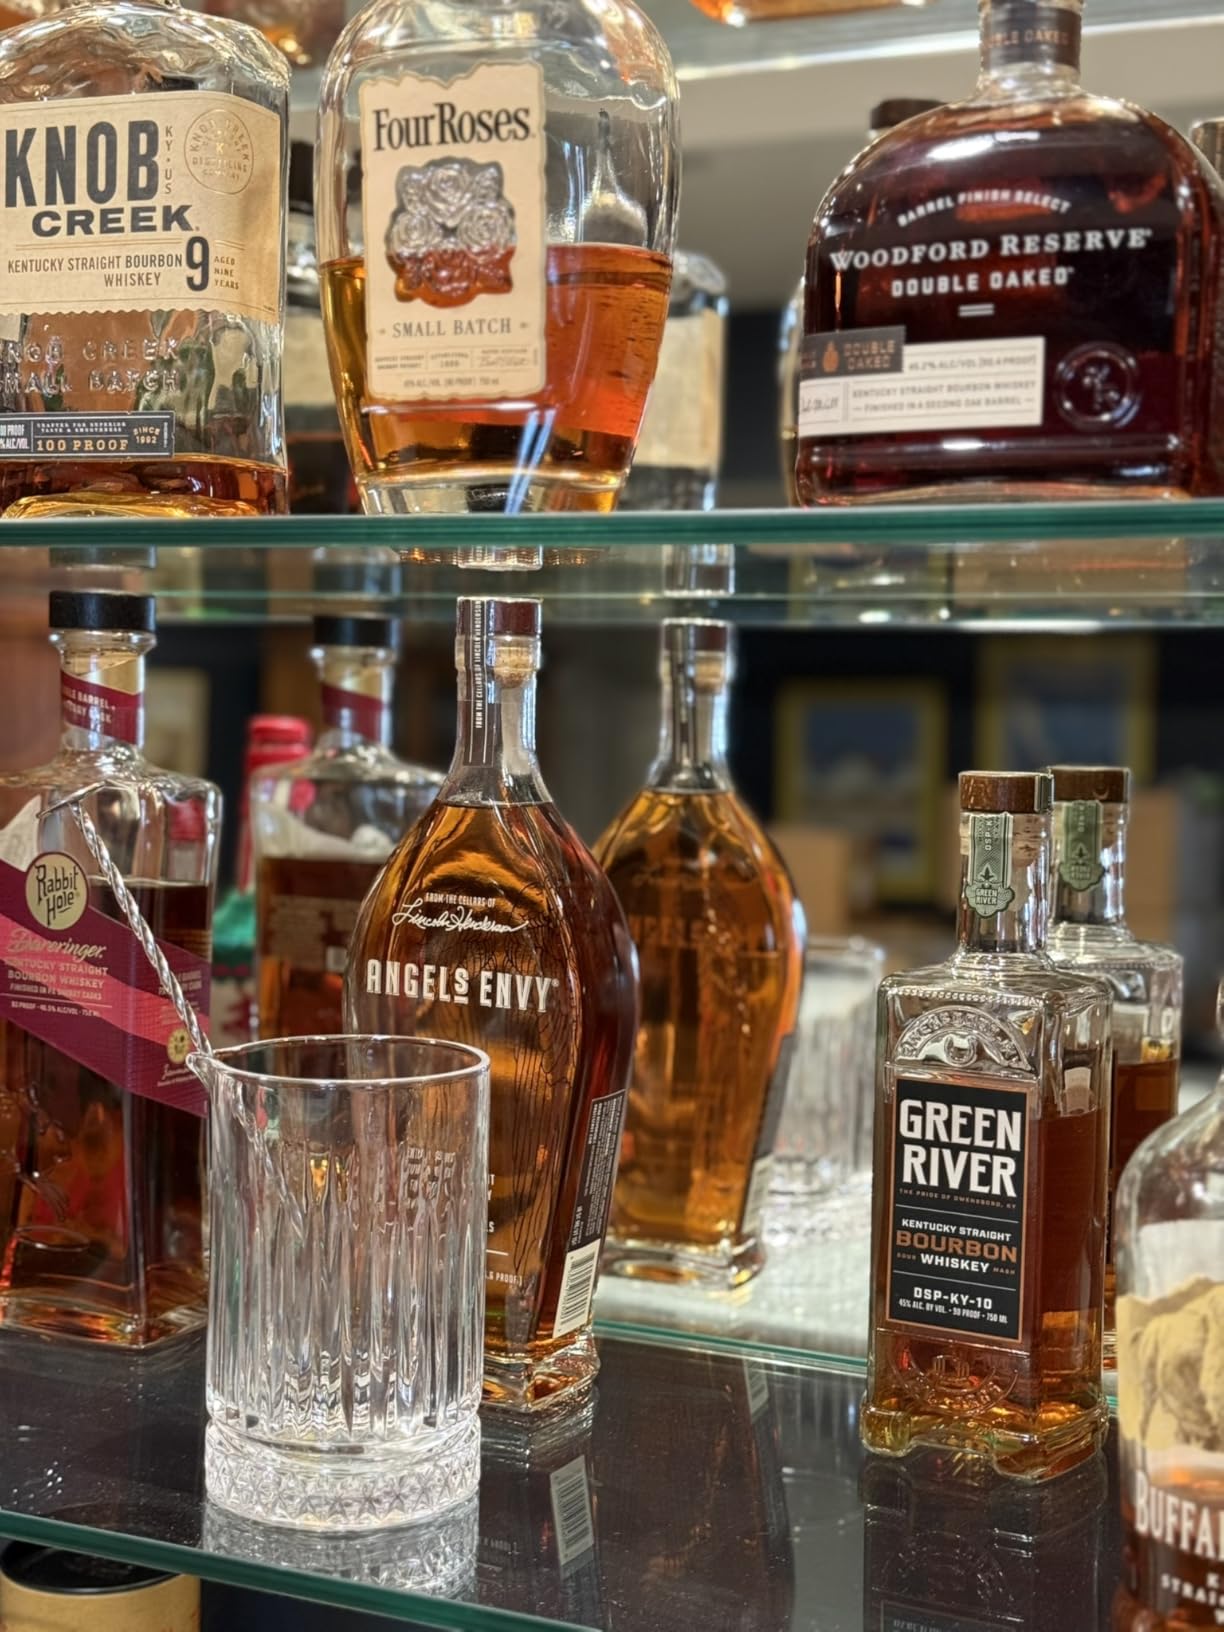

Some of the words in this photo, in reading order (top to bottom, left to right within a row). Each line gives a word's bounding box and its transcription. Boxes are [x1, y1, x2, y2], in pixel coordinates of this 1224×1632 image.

[5, 120, 159, 208] KNOB
[897, 196, 955, 227] BARREL
[957, 189, 1011, 205] FINISH
[1014, 190, 1071, 214] SELECT
[32, 204, 193, 237] CREEK
[830, 238, 990, 271] WOODFORD
[1000, 228, 1147, 257] RESERVE
[8, 257, 64, 274] KENTUCKY
[68, 255, 122, 271] STRAIGHT
[126, 254, 182, 268] BOURBON
[186, 236, 210, 292] 9
[214, 255, 236, 266] AGED
[104, 272, 161, 287] WHISKEY
[214, 267, 234, 278] NINE
[891, 273, 979, 297] DOUBLE
[990, 267, 1068, 291] OAKED
[214, 278, 240, 290] YEARS
[392, 320, 446, 338] SMALL
[453, 317, 512, 336] BATCH
[844, 340, 895, 355] DOUBLE
[848, 355, 891, 369] OAKED
[900, 385, 943, 396] STRAIGHT
[947, 383, 990, 394] BOURBON
[993, 380, 1036, 391] WHISKEY
[133, 425, 161, 436] SINCE
[36, 439, 67, 452] 100
[72, 438, 129, 451] PROOF
[77, 690, 109, 710] BARREL
[35, 864, 79, 905] Rabbit
[975, 887, 998, 897] GREEN
[46, 891, 75, 926] Hole
[425, 892, 444, 904] FROM
[458, 895, 486, 907] CELLARS
[487, 897, 496, 909] OF
[975, 896, 997, 905] RIVER
[8, 970, 57, 984] BOURBON
[60, 975, 104, 989] WHISKEY
[59, 963, 109, 976] STRAIGHT
[366, 958, 469, 1004] ANGELS
[480, 970, 552, 1012] ENVY
[899, 1099, 1022, 1152] GREEN
[903, 1144, 1017, 1198] RIVER
[899, 1187, 913, 1195] THE
[916, 1190, 938, 1198] PRIDE
[901, 1218, 957, 1234] KENTUCKY
[959, 1226, 1012, 1242] STRAIGHT
[896, 1230, 1017, 1263] BOURBON
[897, 1252, 917, 1260] SOUR
[920, 1253, 990, 1273] WHISKEY
[993, 1267, 1015, 1275] MASH
[913, 1287, 993, 1310] DSP-KY-10
[898, 1298, 911, 1308] 45%
[925, 1302, 934, 1311] BY
[953, 1307, 961, 1316] 90
[962, 1308, 981, 1319] PROOF
[987, 1312, 998, 1322] 750
